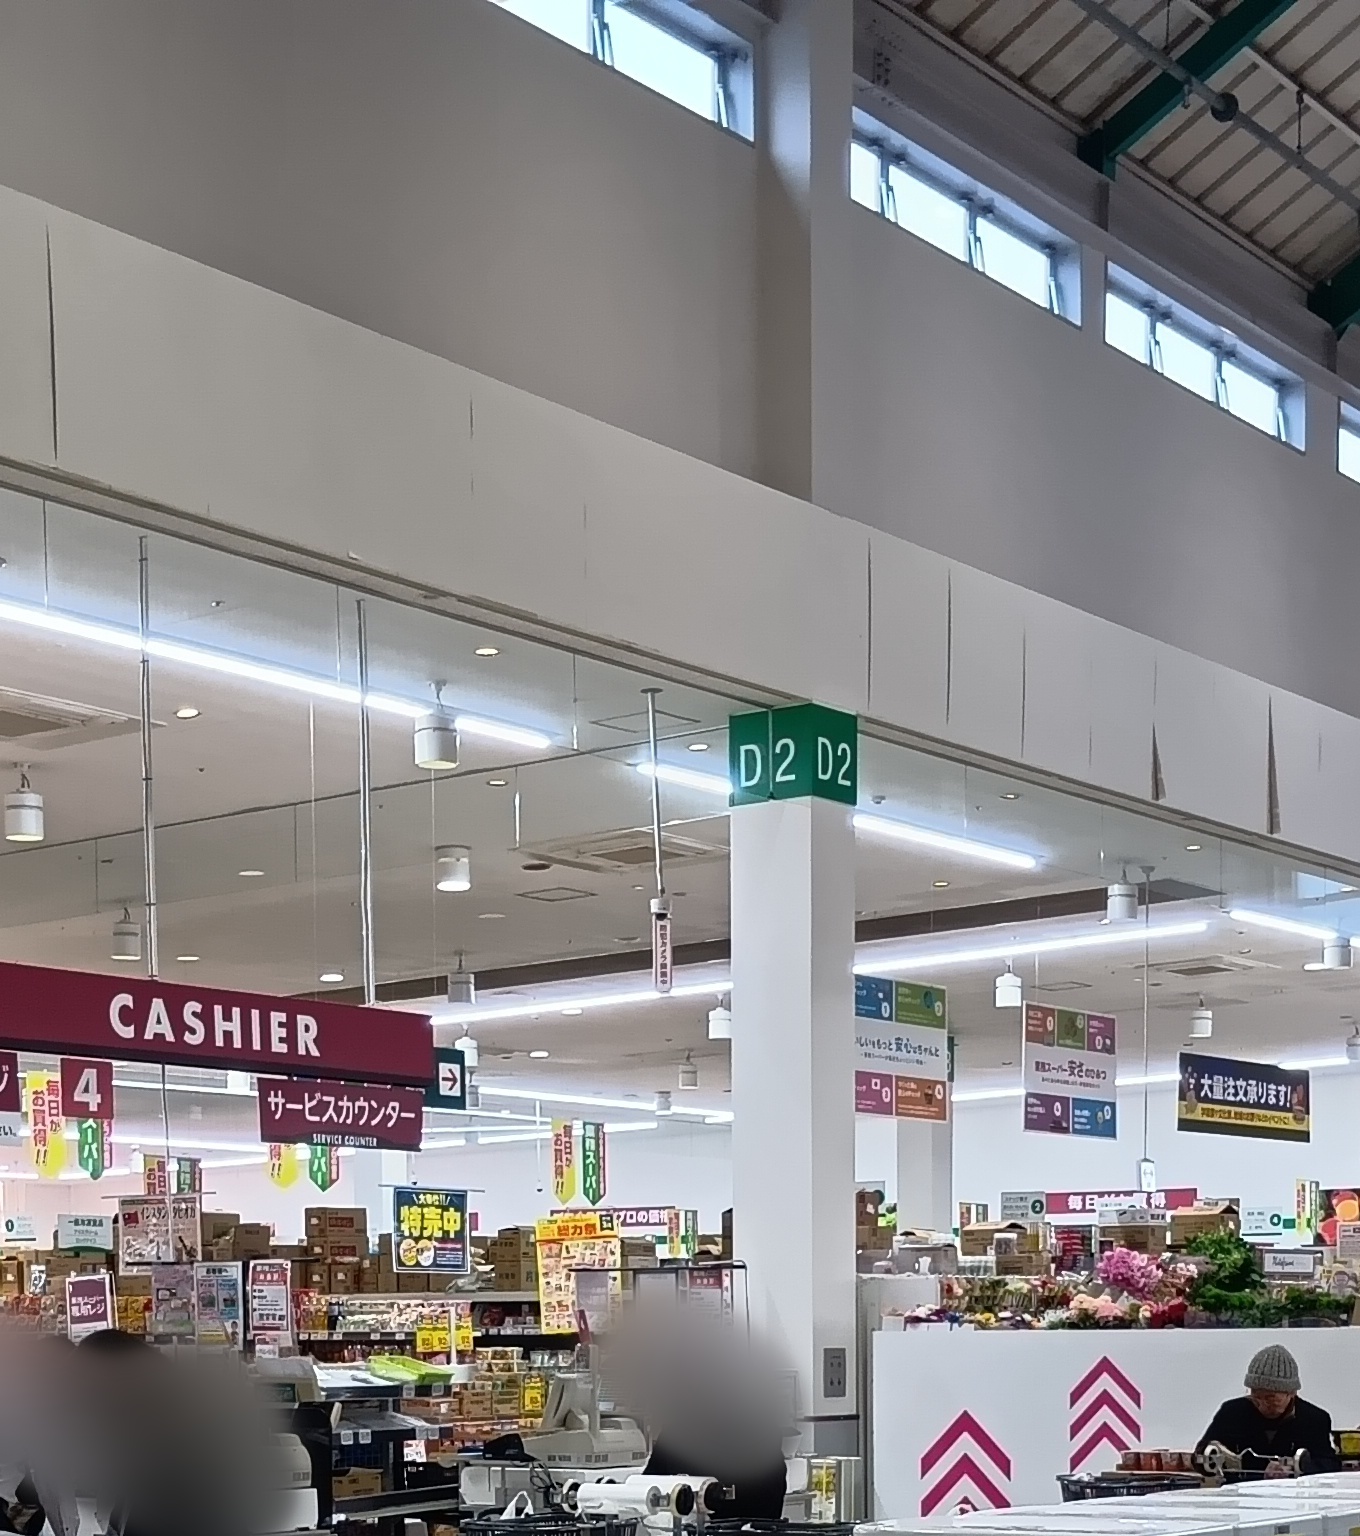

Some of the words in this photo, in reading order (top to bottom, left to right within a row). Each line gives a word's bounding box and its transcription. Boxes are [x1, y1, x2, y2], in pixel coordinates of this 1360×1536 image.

[739, 738, 796, 788] D2
[817, 736, 852, 786] D2
[109, 992, 322, 1057] CASHIER
[73, 1068, 101, 1112] 4
[268, 1092, 416, 1128] サービスカウンター
[1200, 1073, 1291, 1108] 大量注文承ります!
[313, 1133, 342, 1145] SERVICE
[344, 1135, 377, 1147] COUNTER
[400, 1205, 461, 1238] 特売中
